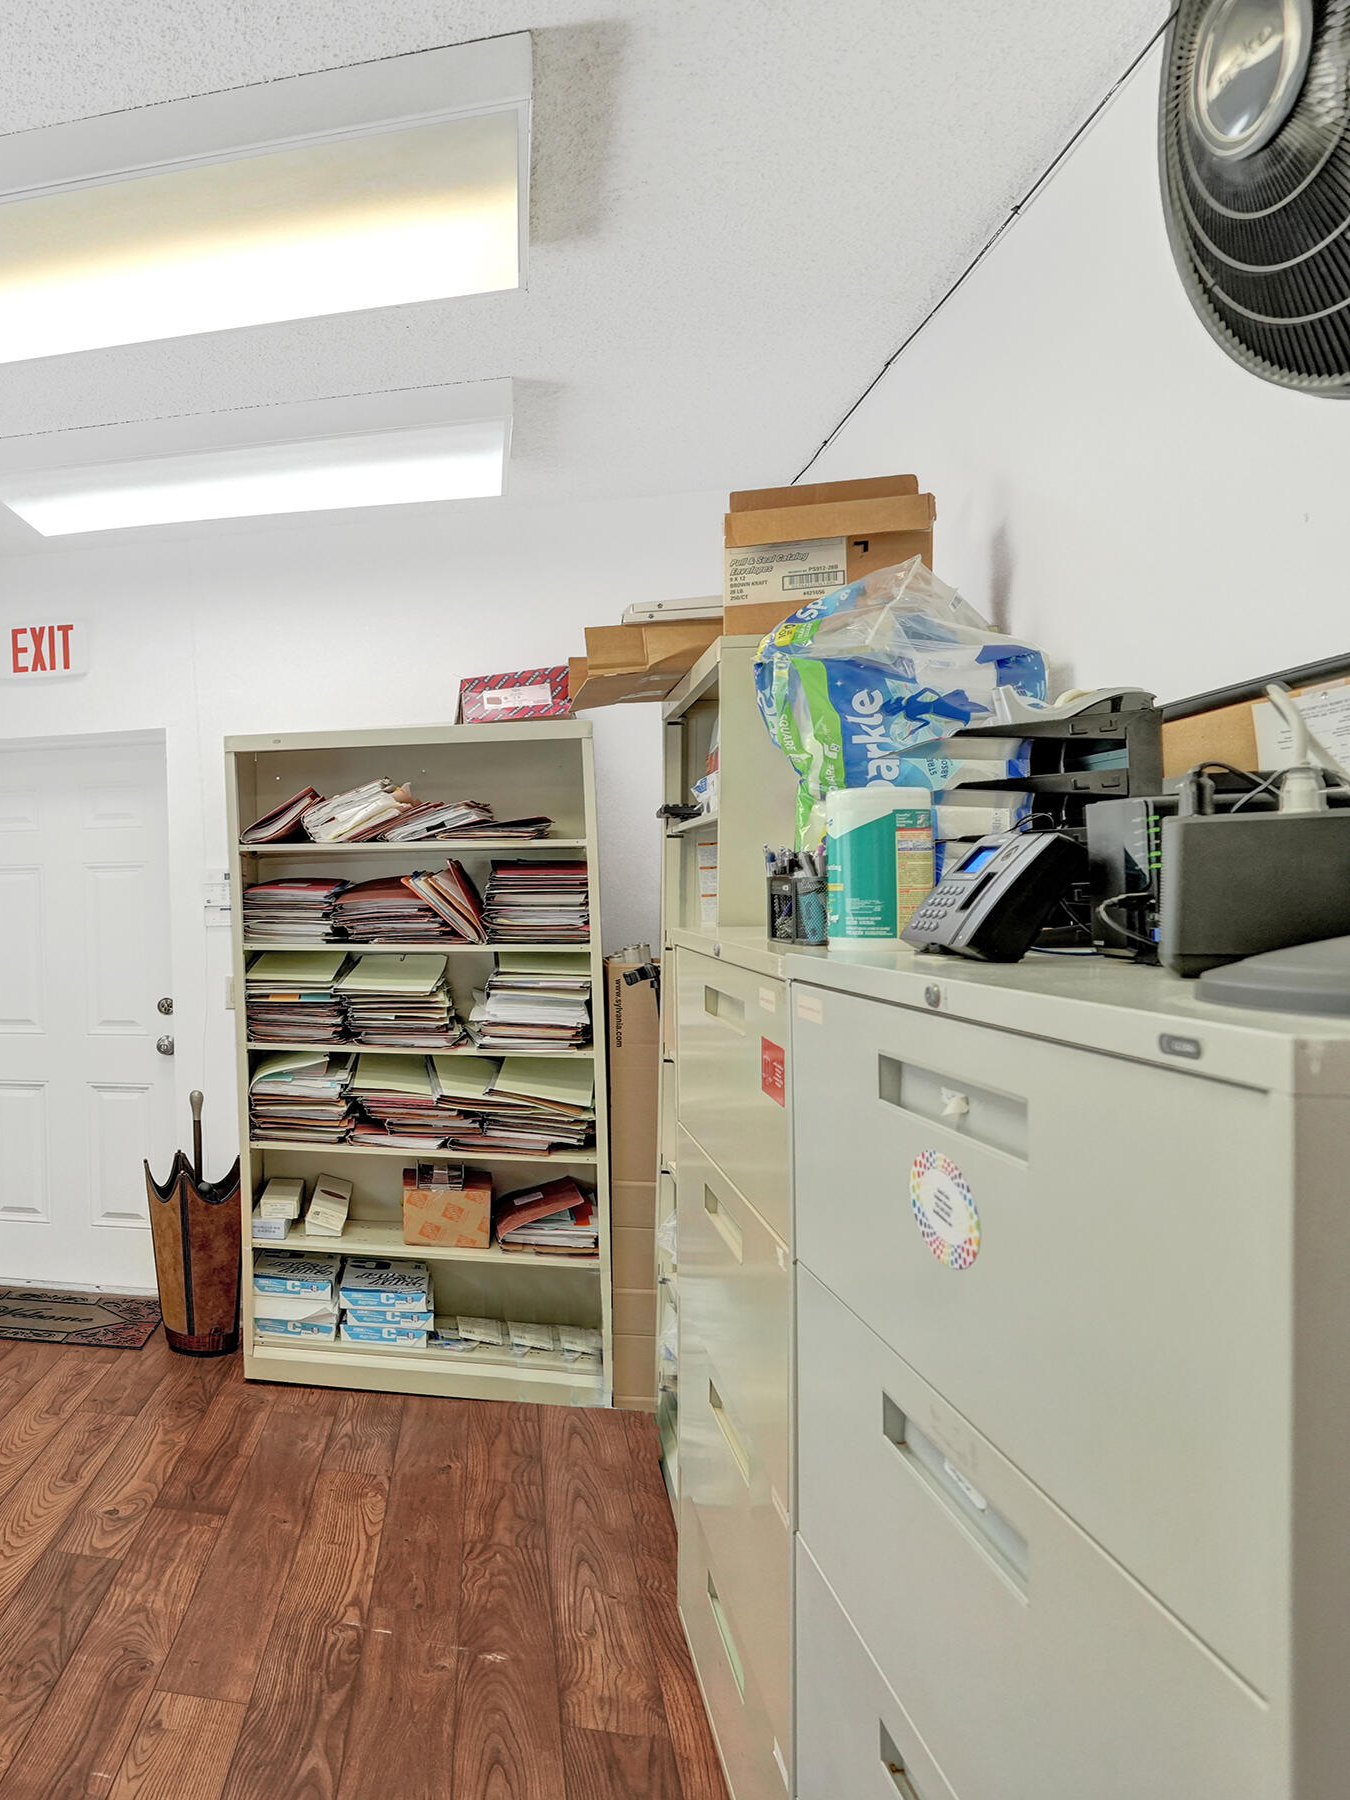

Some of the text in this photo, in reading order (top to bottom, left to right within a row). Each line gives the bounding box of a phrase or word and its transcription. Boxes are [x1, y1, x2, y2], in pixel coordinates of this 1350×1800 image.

[730, 558, 749, 567] Pull
[756, 555, 775, 564] Seal
[775, 552, 810, 563] Catalog
[730, 566, 774, 577] Envelopes
[11, 624, 74, 674] EXIT
[926, 757, 938, 776] STRE
[940, 759, 950, 779] ABSO
[613, 978, 624, 1048] www.sylvania.com
